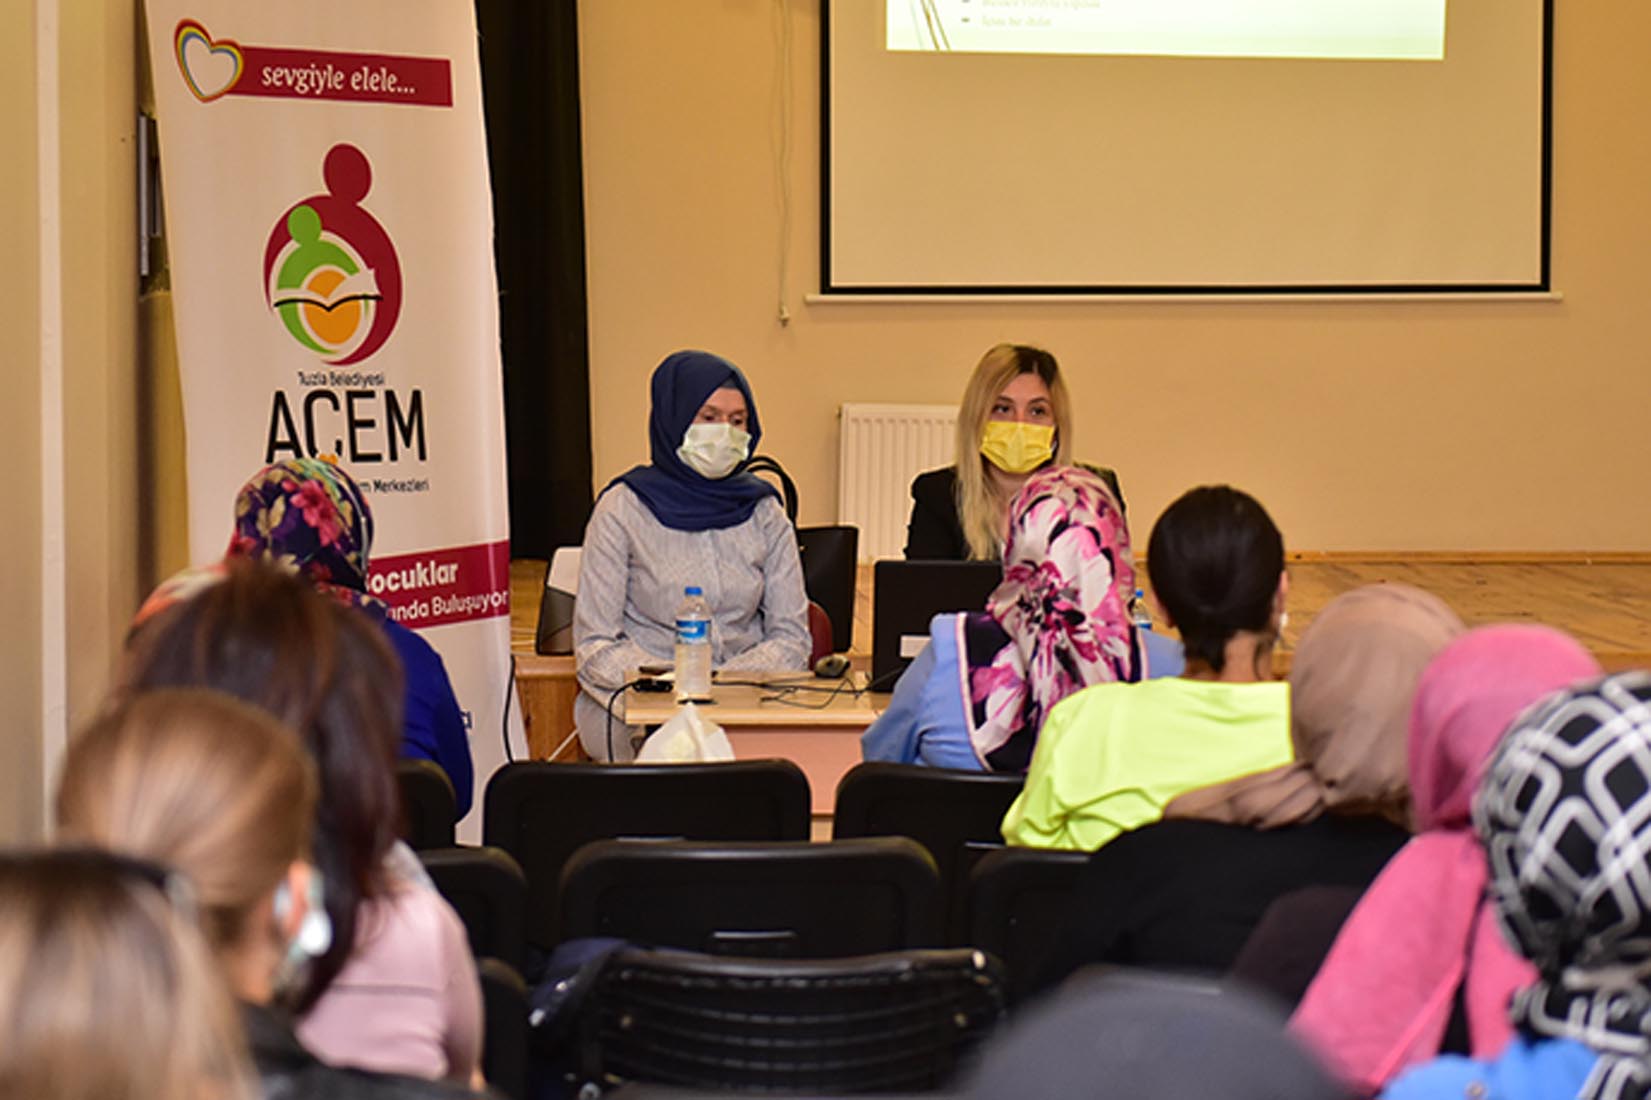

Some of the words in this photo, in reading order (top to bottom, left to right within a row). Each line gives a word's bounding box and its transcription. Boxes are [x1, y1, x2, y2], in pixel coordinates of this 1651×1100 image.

[261, 63, 345, 95] sevgiyle
[329, 371, 385, 389] Belediyesi
[373, 478, 430, 493] Merkezleri
[365, 560, 459, 595] ocuklar
[432, 591, 508, 616] Buluşuyor
